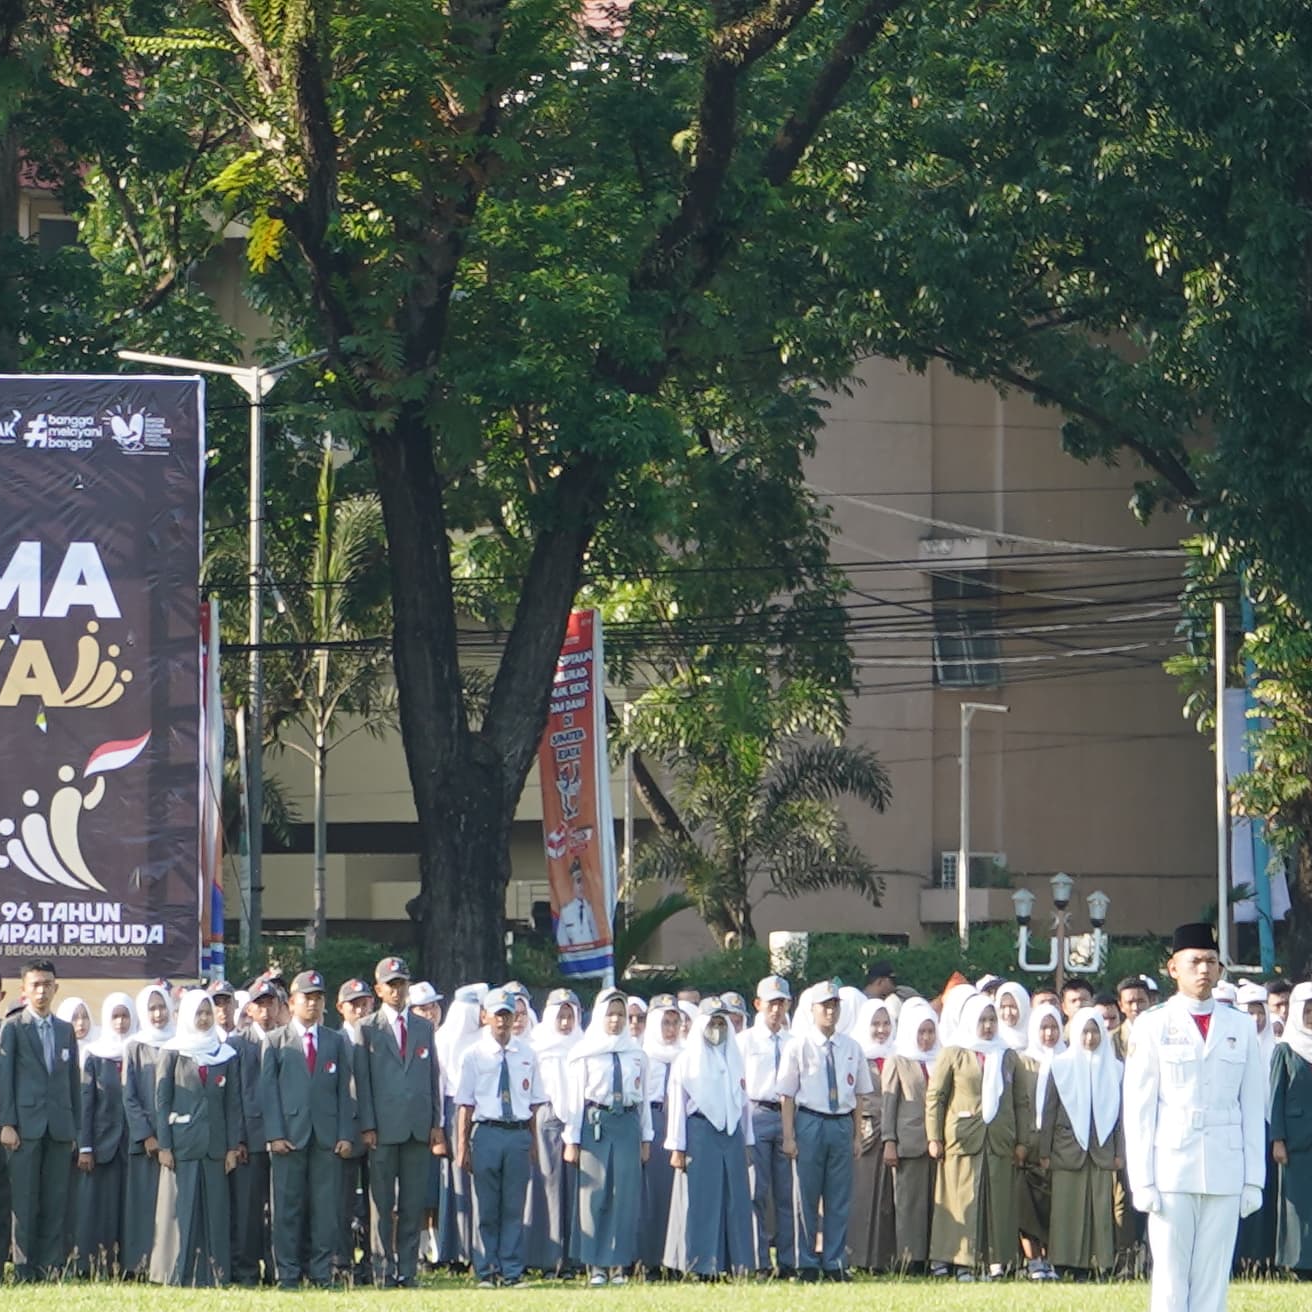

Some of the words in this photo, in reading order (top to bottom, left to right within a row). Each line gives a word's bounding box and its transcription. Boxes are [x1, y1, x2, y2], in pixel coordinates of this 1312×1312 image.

[47, 414, 94, 427] bangga
[48, 425, 103, 439] melayani
[48, 438, 92, 451] bangsa
[1, 902, 34, 922] 96
[39, 902, 121, 922] TAHUN
[63, 924, 164, 945] PEMUDA
[4, 945, 58, 956] BERSAMA
[59, 945, 118, 957] INDONESIA
[120, 946, 147, 957] RAYA
